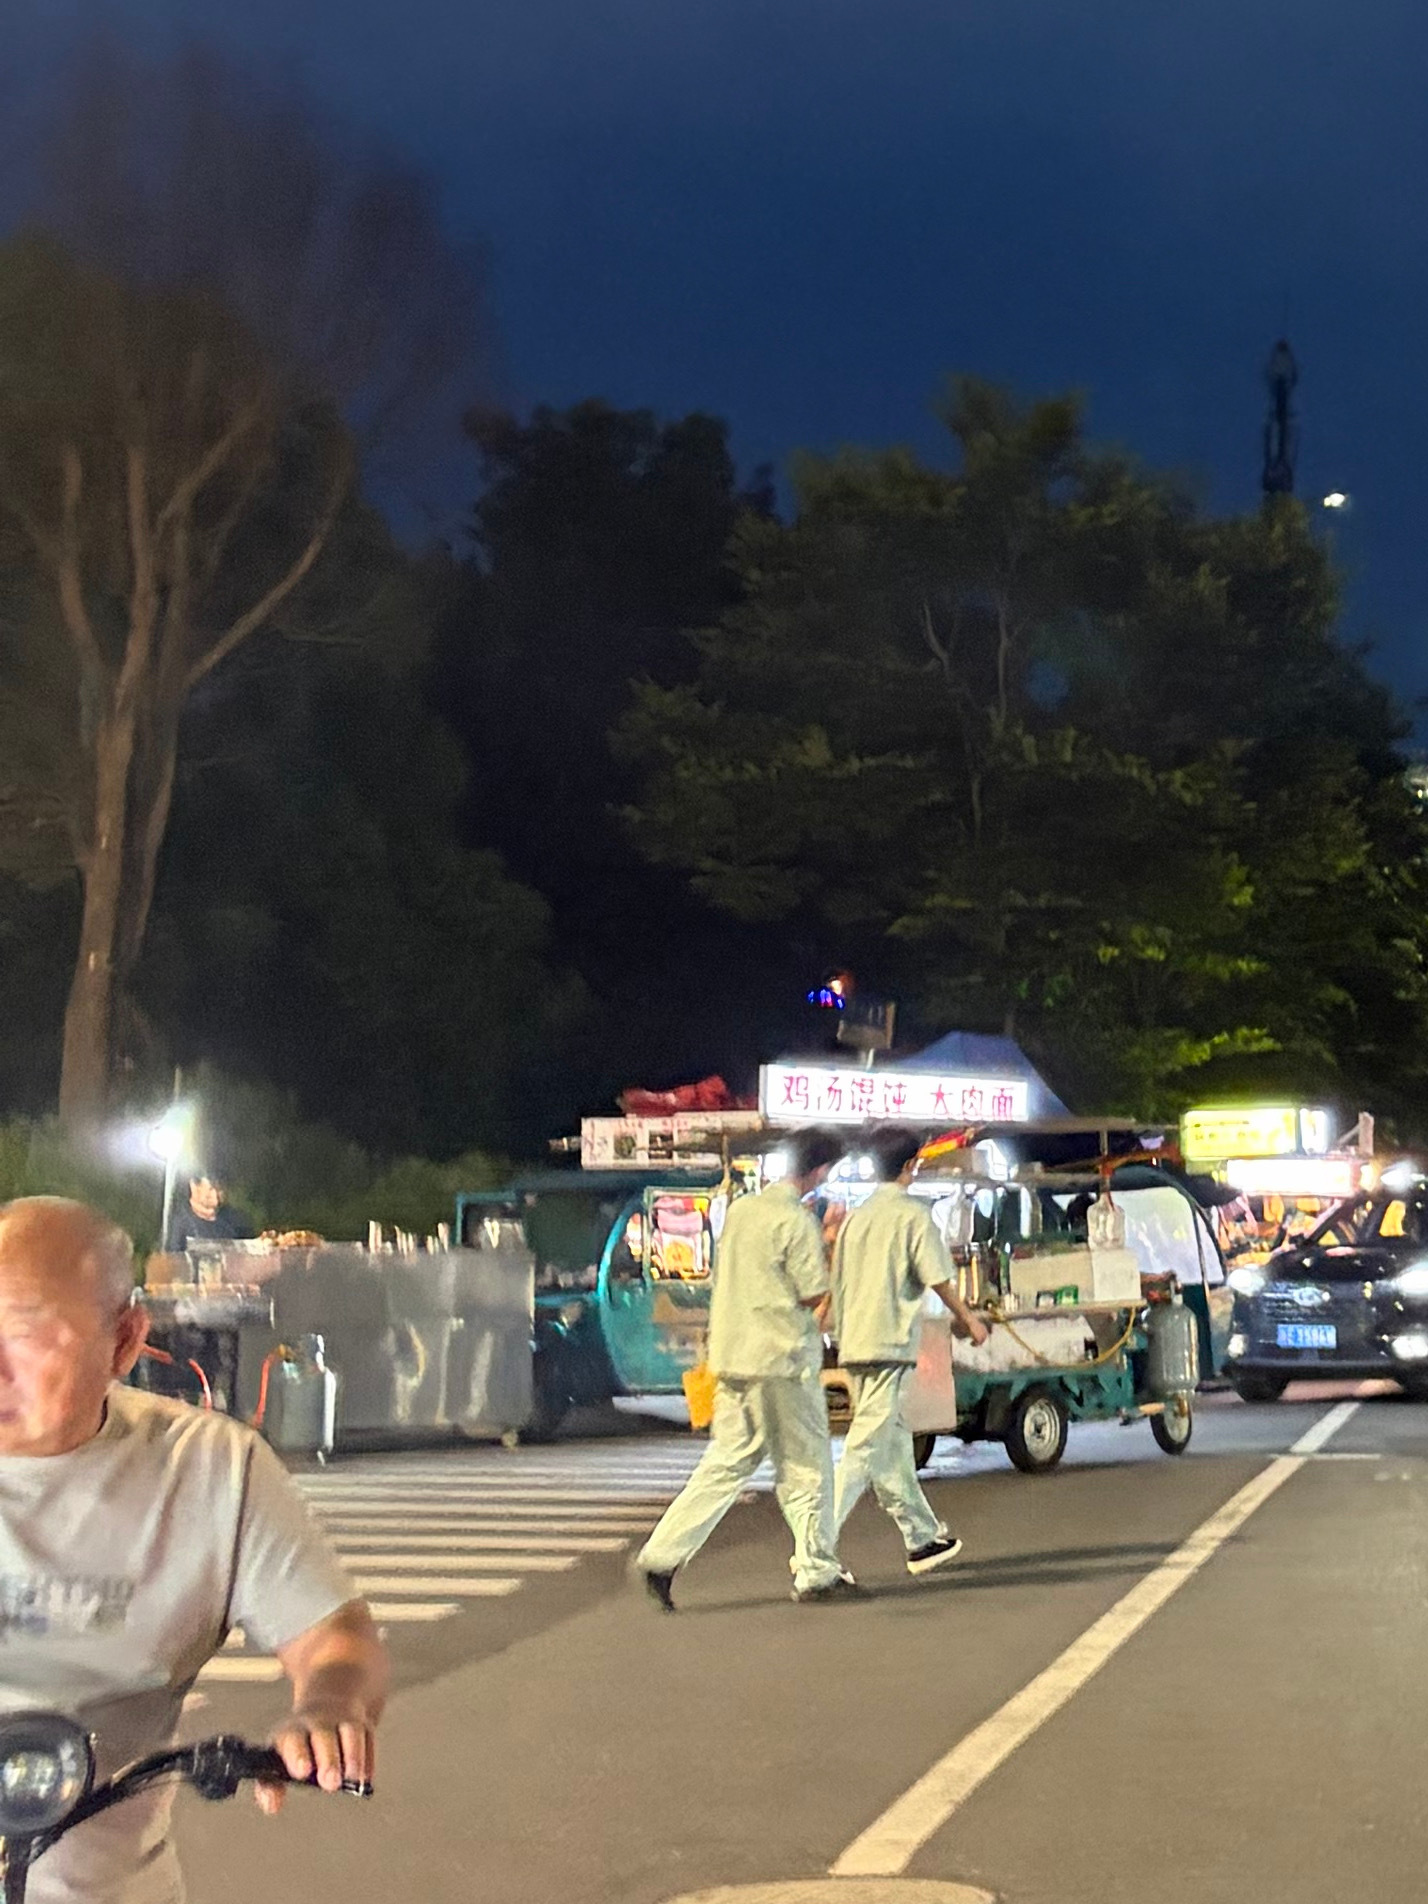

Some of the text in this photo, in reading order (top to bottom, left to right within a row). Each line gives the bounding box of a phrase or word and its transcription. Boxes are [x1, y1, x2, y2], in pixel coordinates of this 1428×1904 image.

[781, 1075, 1016, 1120] 鸡汤馄饨 大肉面
